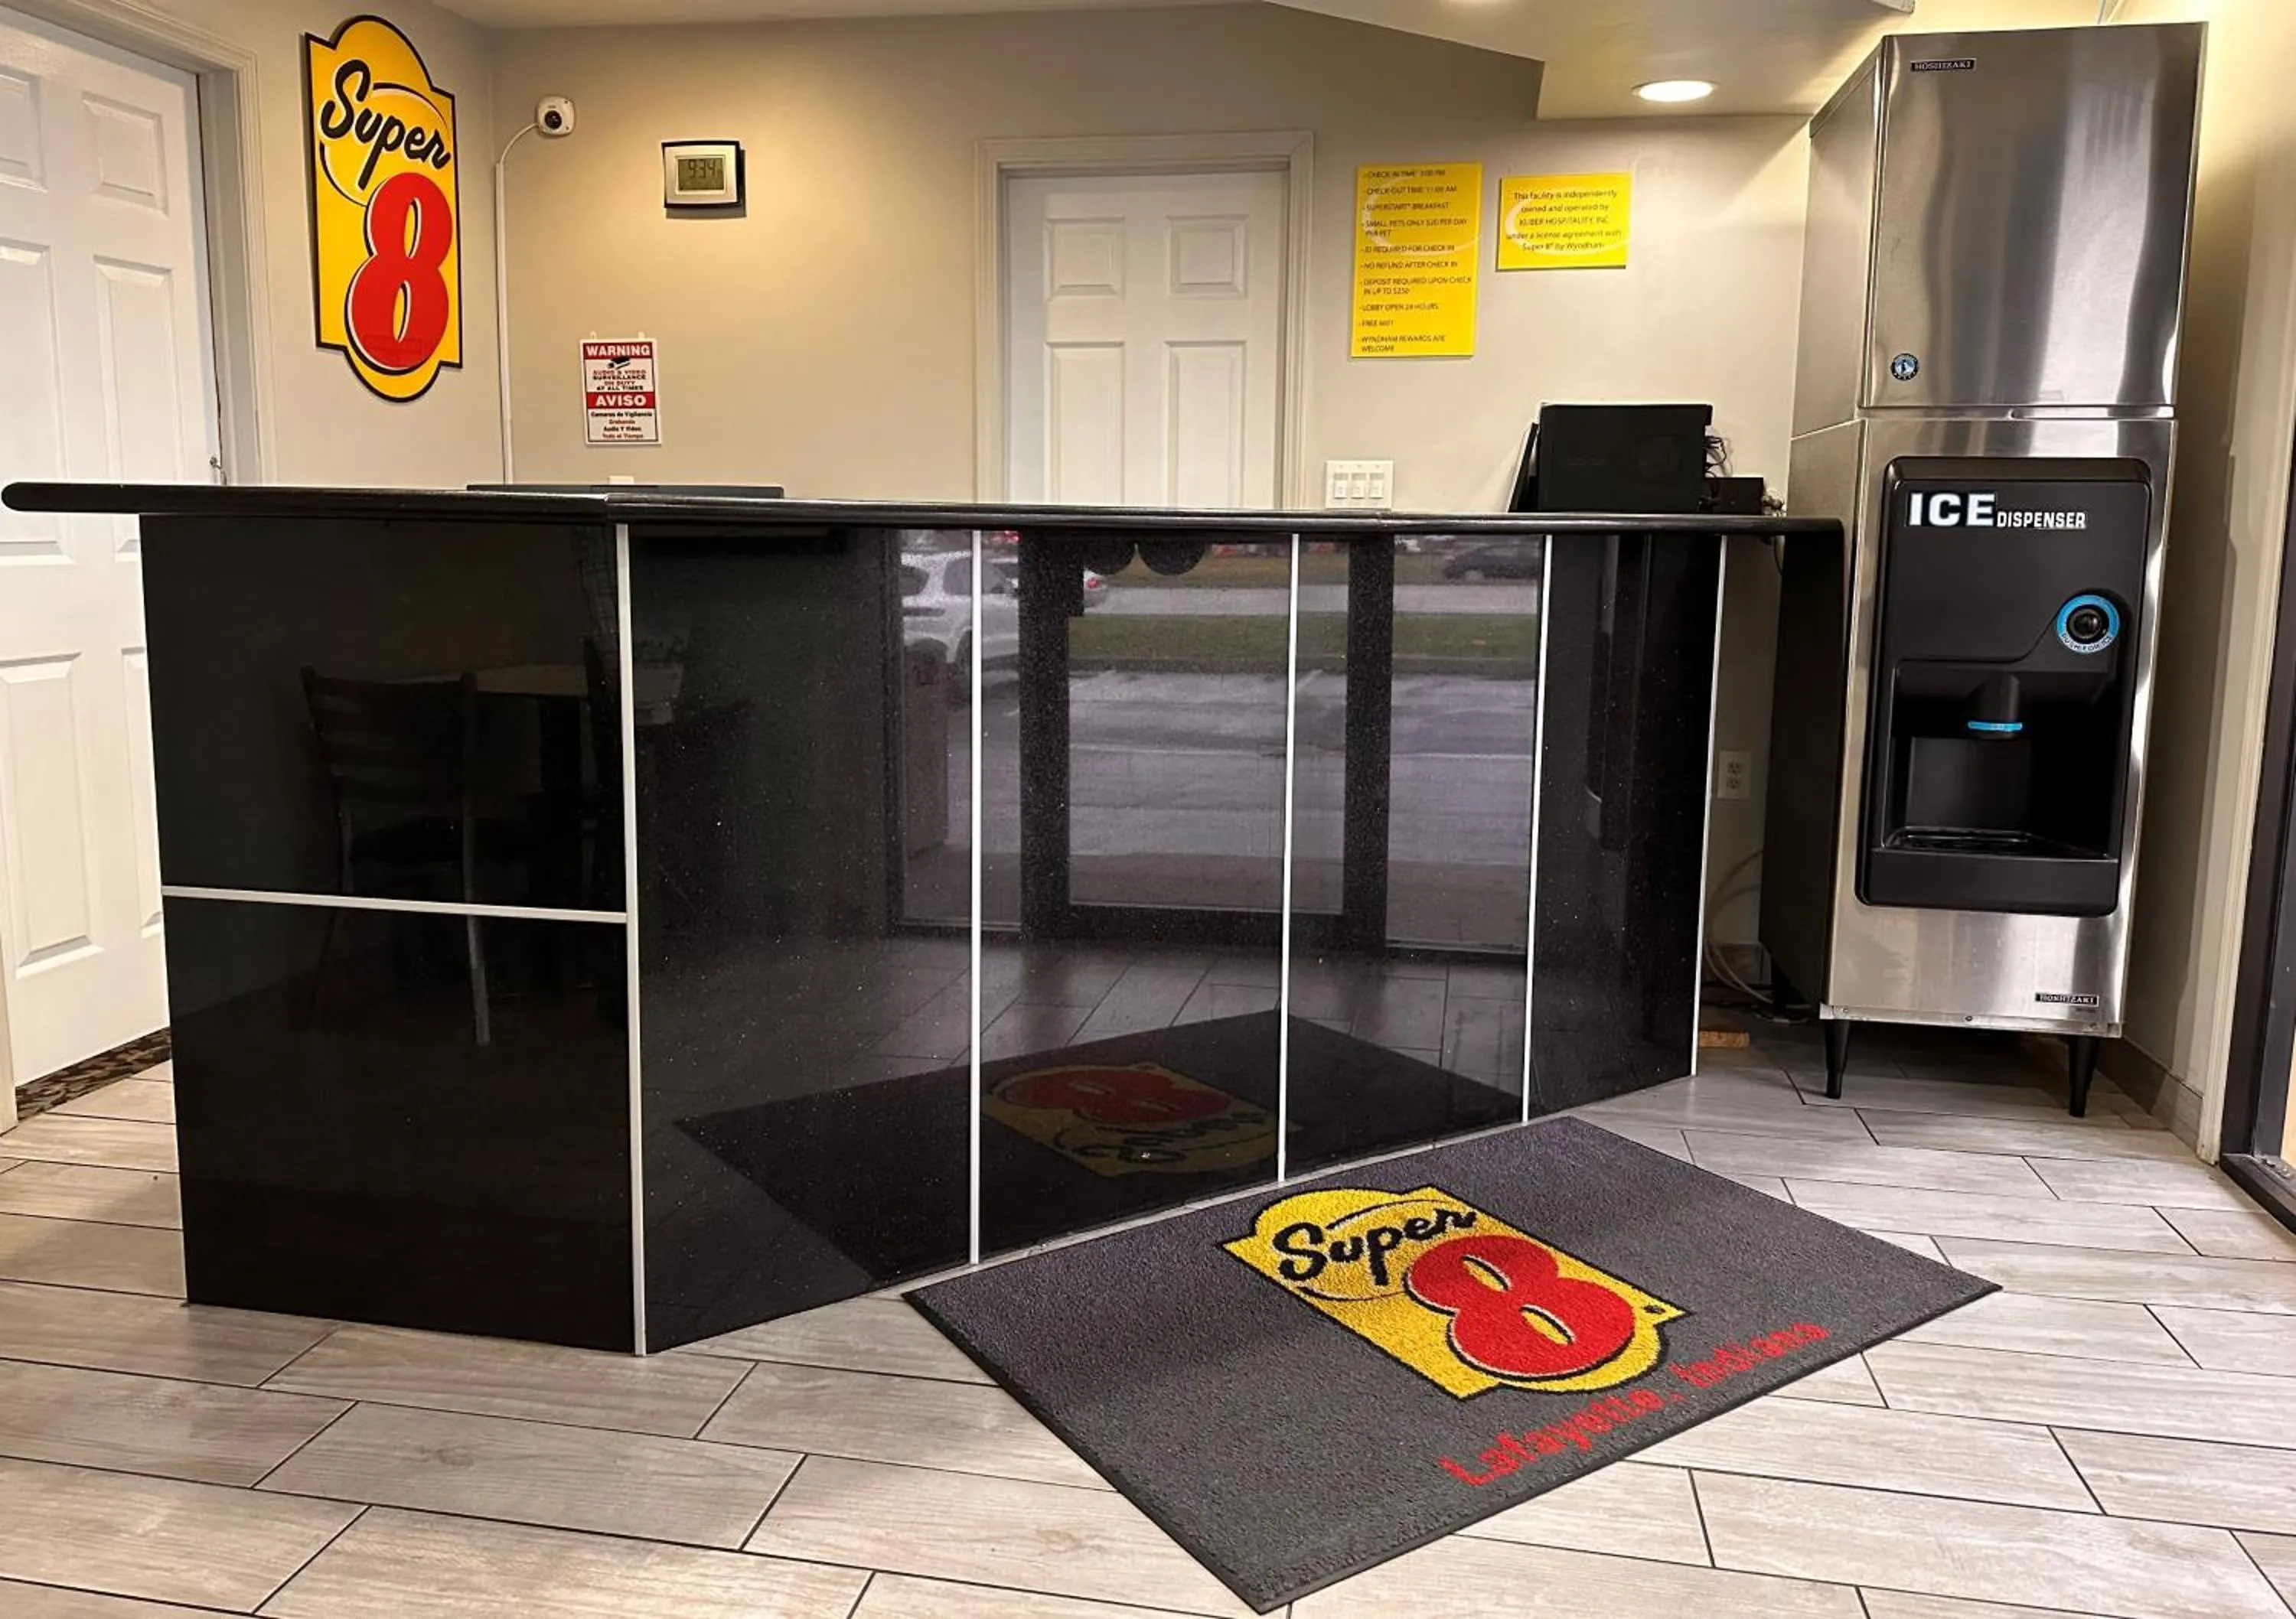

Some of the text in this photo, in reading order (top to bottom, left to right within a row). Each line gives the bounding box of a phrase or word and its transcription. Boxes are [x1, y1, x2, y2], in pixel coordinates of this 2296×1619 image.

[1914, 60, 1971, 70] HOSHIZAKI
[320, 60, 451, 191] Super
[1366, 186, 1390, 195] CHECK
[1514, 191, 1528, 200] This
[1529, 191, 1554, 200] facility
[1563, 189, 1617, 199] independently
[1521, 204, 1547, 213] owned
[1548, 204, 1563, 212] and
[1564, 204, 1599, 213] operated
[1562, 230, 1603, 240] agreement
[1423, 244, 1446, 252] CHECK
[1522, 243, 1544, 252] Super
[1426, 260, 1449, 269] CHECK
[344, 172, 453, 376] 8
[1362, 335, 1398, 344] WYNDHAM
[1399, 334, 1431, 343] REWARDS
[586, 345, 651, 357] WARNING
[595, 394, 647, 407] AVISO
[1909, 492, 2087, 529] ICE DISPENSER
[1273, 1207, 1477, 1285] Super
[1402, 1235, 1638, 1383] 8
[1438, 1319, 1831, 1486] Lafayette, Indiana
